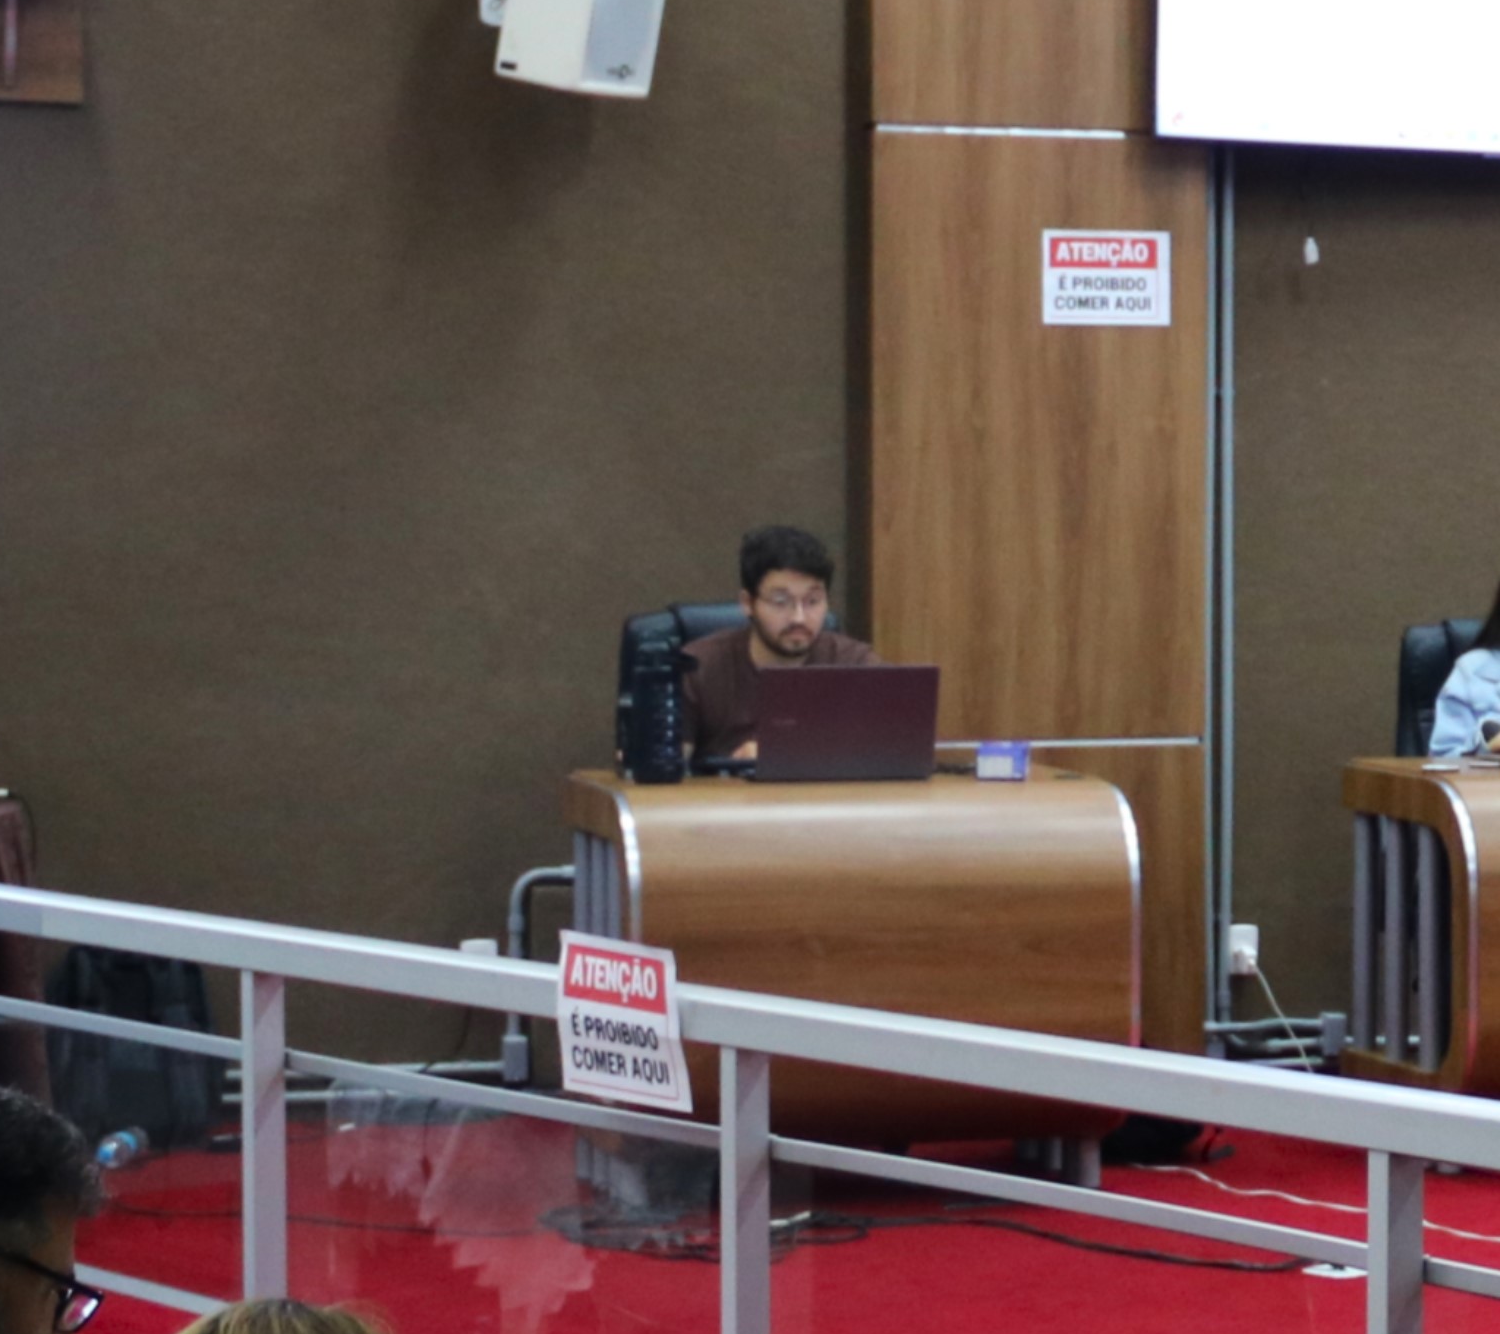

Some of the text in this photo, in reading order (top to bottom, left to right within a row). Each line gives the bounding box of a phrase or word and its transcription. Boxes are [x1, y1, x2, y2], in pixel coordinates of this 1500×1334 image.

[1056, 239, 1149, 267] ATENÇÃO
[1058, 273, 1147, 291] É PROIBIDO
[1054, 296, 1152, 312] COMER AQUI
[570, 953, 658, 1004] ATENÇÃO
[570, 1006, 659, 1051] É PROIBIDO
[572, 1046, 671, 1085] COMER AQUI
